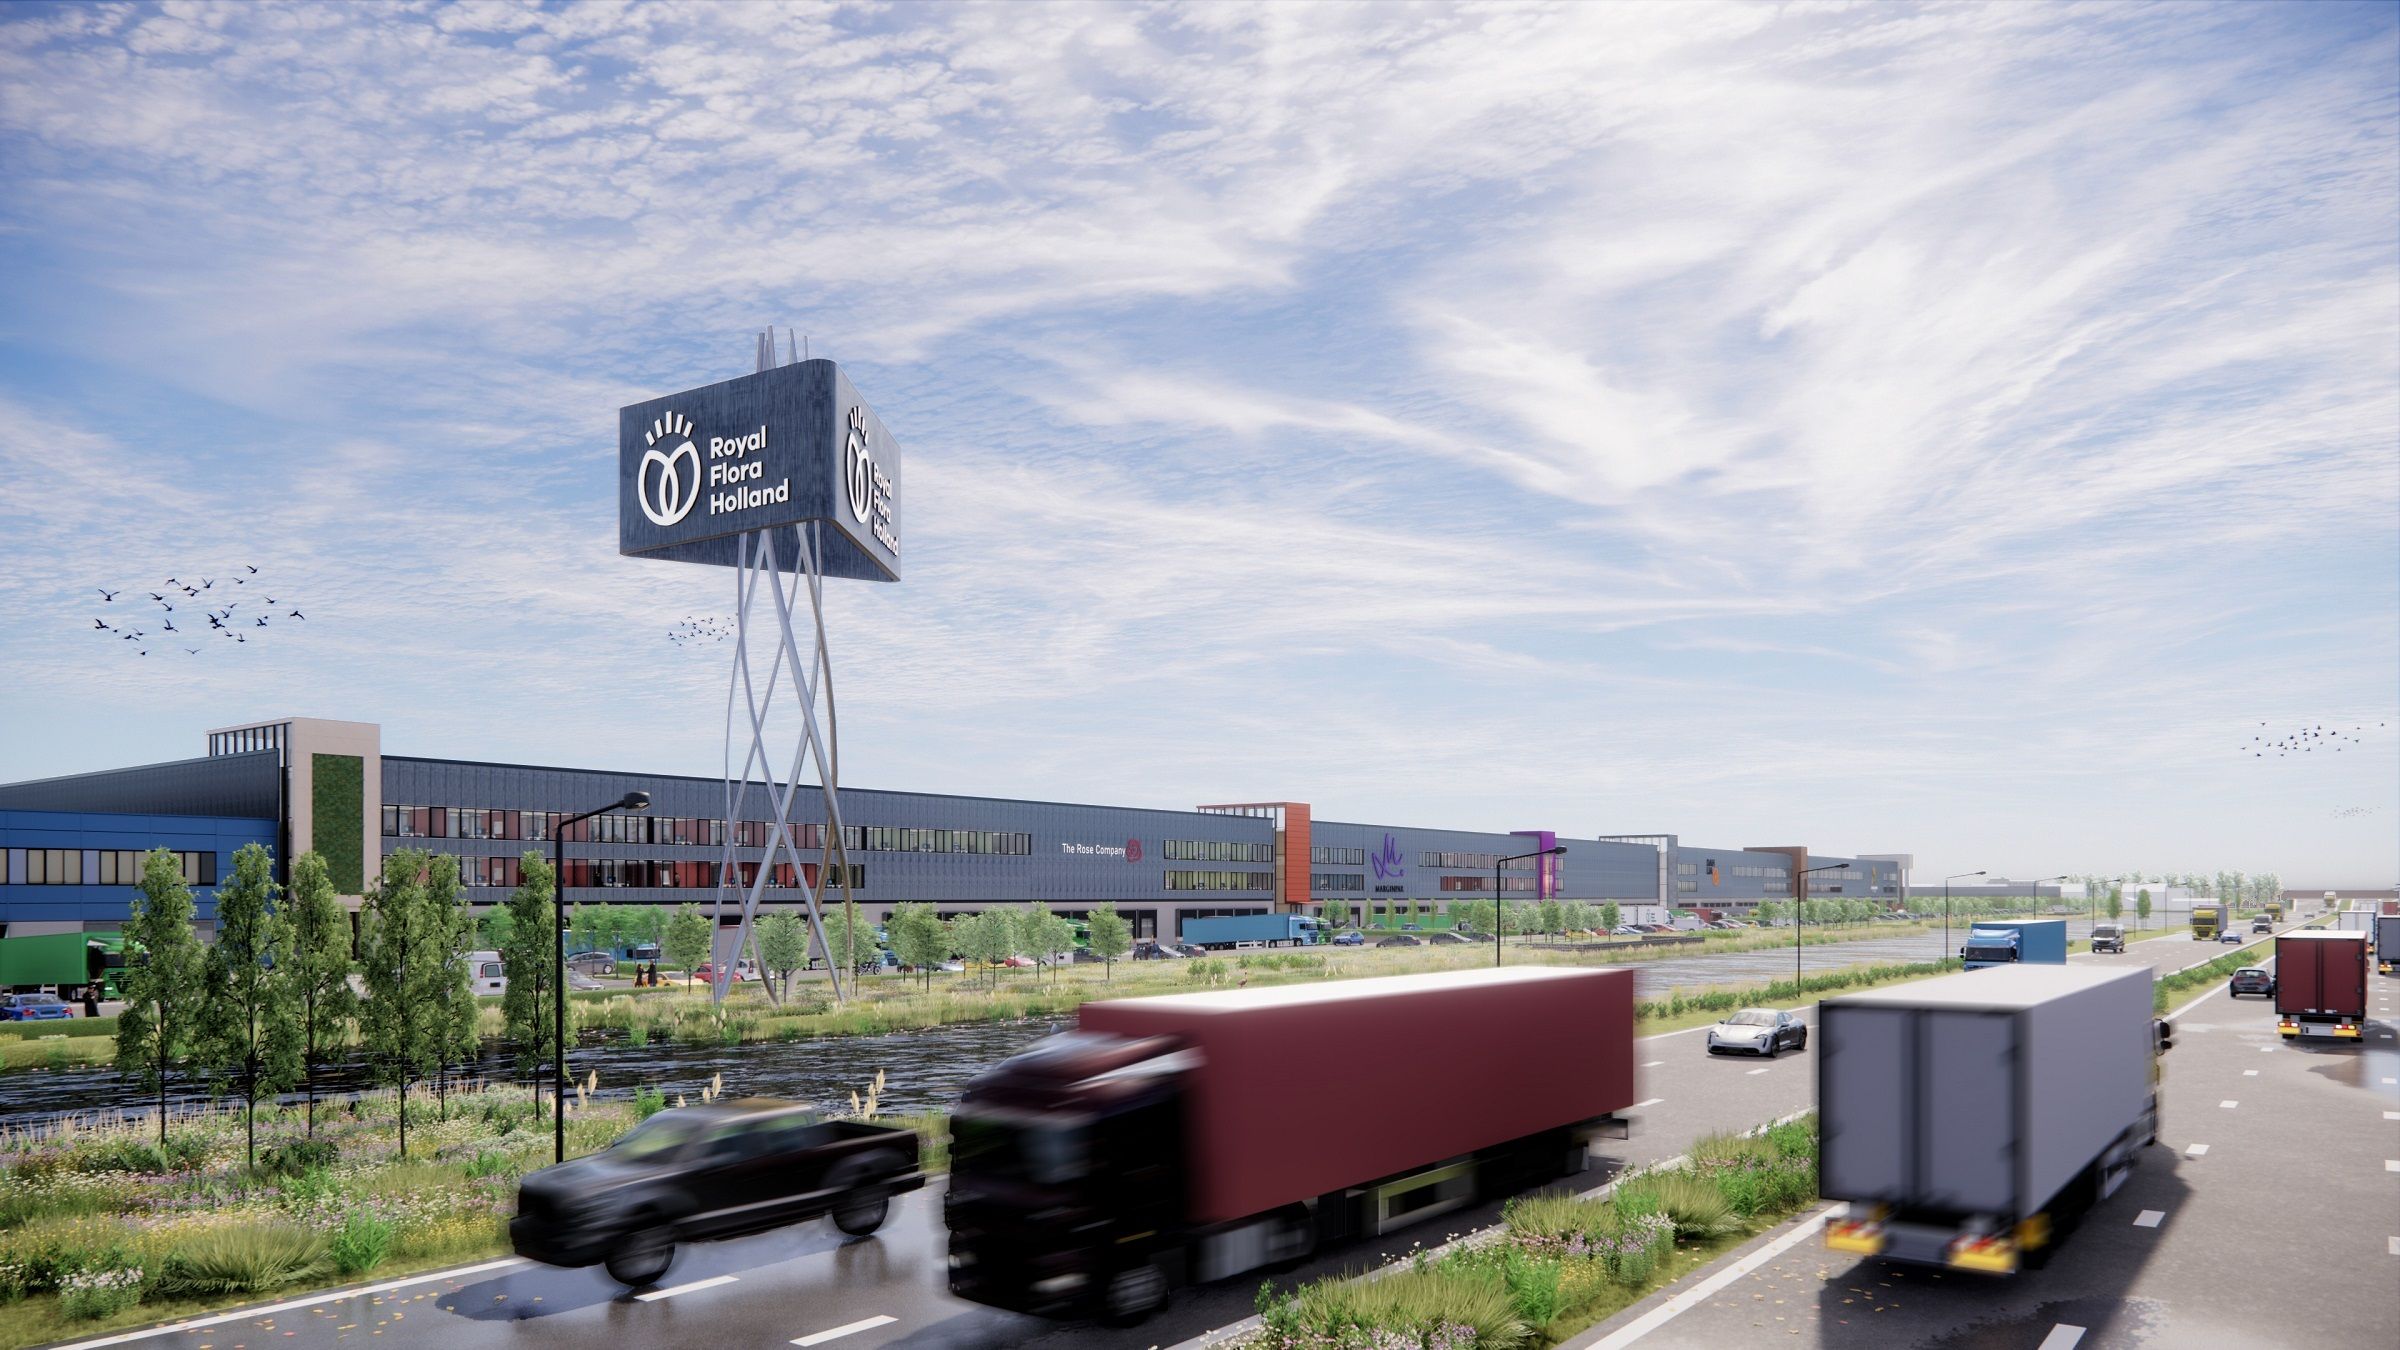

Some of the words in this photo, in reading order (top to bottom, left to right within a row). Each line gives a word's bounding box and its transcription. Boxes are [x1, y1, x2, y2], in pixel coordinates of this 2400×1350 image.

[710, 425, 767, 459] Royal
[710, 460, 763, 487] Flora
[873, 462, 892, 500] Royal
[710, 478, 790, 515] Holland
[873, 489, 891, 524] Flora
[873, 515, 898, 556] Holland
[1062, 843, 1075, 854] The
[1076, 843, 1094, 854] Rose
[1095, 844, 1126, 857] Company
